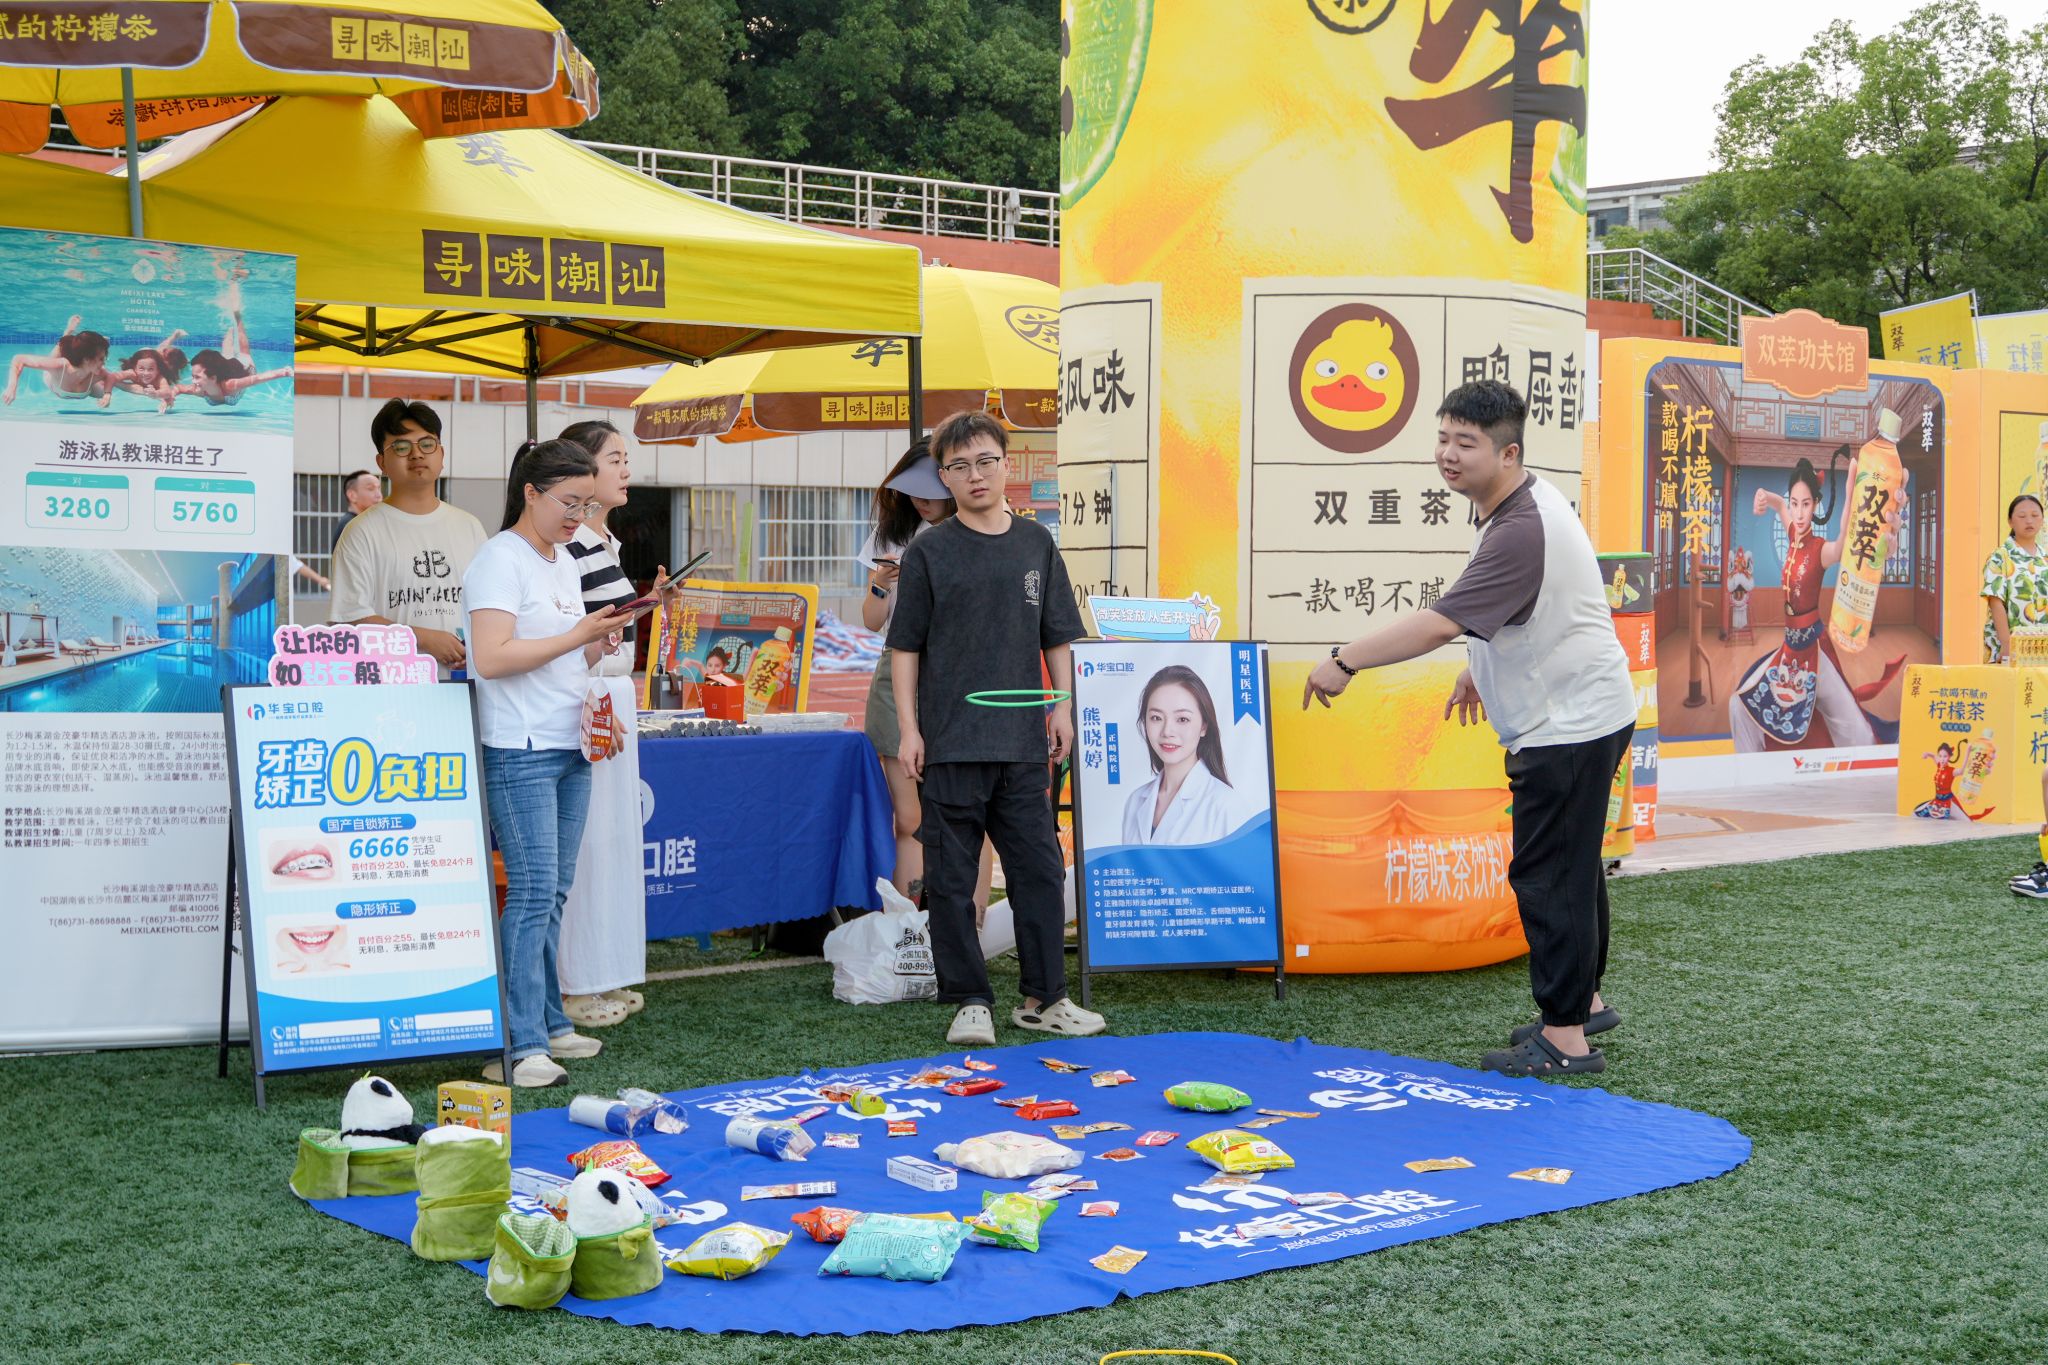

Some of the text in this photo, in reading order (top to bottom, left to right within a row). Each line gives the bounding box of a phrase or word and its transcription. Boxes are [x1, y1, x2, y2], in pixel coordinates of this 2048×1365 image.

[338, 25, 464, 61] 寻味潮汕
[434, 242, 658, 295] 寻味潮汕
[1891, 325, 1904, 351] 双萃
[1758, 334, 1856, 374] 双萃功夫馆
[1462, 343, 1585, 431] 鸭屎香
[1921, 410, 1935, 452] 双萃
[59, 439, 225, 467] 游泳私教课招生了
[1660, 384, 1679, 529] 一款喝不腻的
[57, 475, 98, 486] 一对一
[185, 480, 226, 491] 一对二
[1680, 405, 1714, 554] 柠檬茶
[44, 496, 111, 519] 3280
[172, 501, 238, 523] 5760
[1059, 489, 1112, 525] 7分钟
[1313, 489, 1477, 533] 双重茶
[1850, 485, 1890, 571] 双萃
[1267, 577, 1447, 616] 一款喝不腻
[1096, 607, 1198, 625] 微笑绽放从齿开始
[280, 631, 411, 655] 让你的牙齿
[1639, 629, 1651, 665] 双萃
[275, 661, 432, 686] 如钻石般闪耀
[749, 659, 781, 697] 双萃
[1096, 661, 1135, 673] 华宝口腔
[1238, 649, 1253, 705] 明星医生
[1911, 677, 1922, 698] 双萃
[1929, 687, 1988, 699] 一款喝不腻的
[2024, 682, 2034, 708] 双萃
[268, 702, 323, 714] 华宝口腔
[1928, 700, 1985, 721] 柠檬茶
[1083, 706, 1103, 769] 熊晓婷
[259, 741, 326, 774] 牙齿
[257, 775, 325, 808] 矫正
[327, 817, 403, 832] 国产自锁矫正
[349, 836, 410, 859] 6666
[412, 844, 436, 856] 元起
[1385, 832, 1514, 904] 柠檬味茶饮料
[351, 902, 402, 917] 隐形矫正
[120, 924, 220, 935] MEIXILAKEHOTEL.COM
